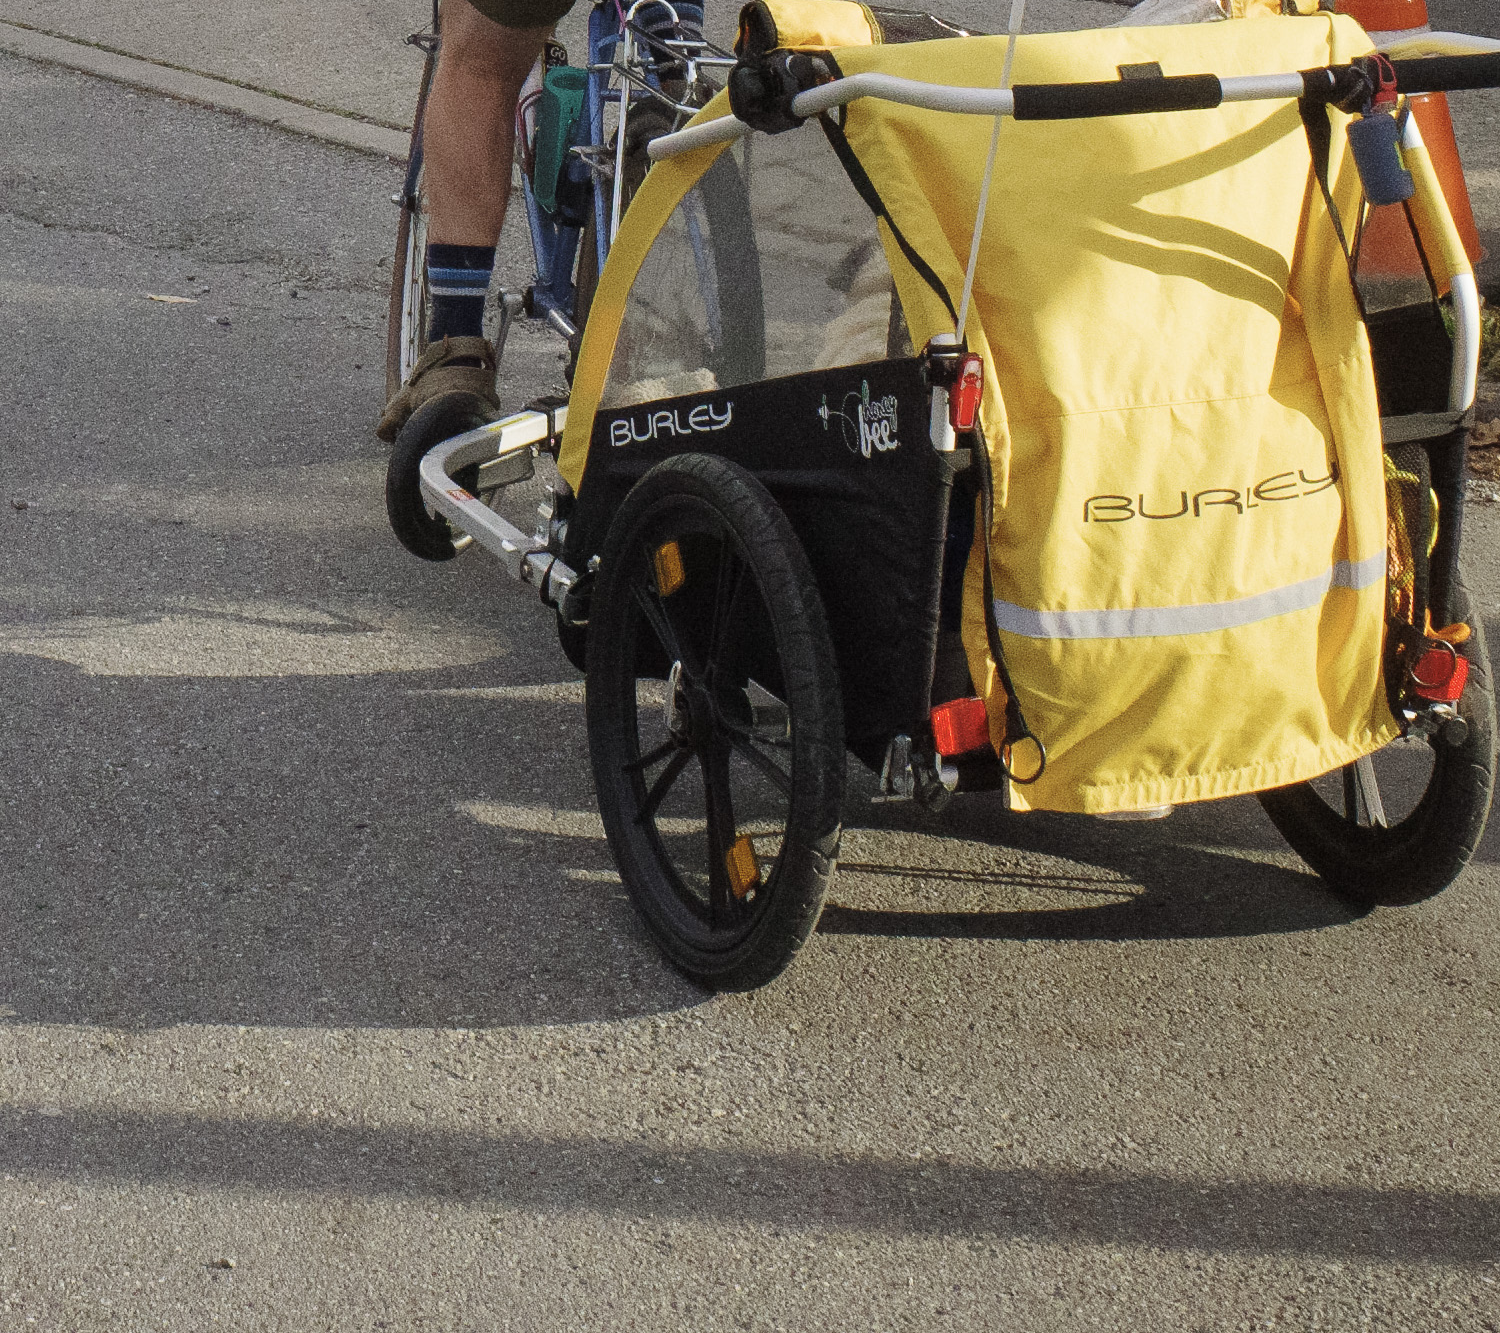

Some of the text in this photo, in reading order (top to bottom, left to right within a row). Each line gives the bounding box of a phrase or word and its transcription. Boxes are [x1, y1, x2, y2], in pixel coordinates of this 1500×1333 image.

[610, 401, 733, 447] BURLEY
[858, 403, 899, 458] bee
[862, 379, 898, 433] honey
[1083, 463, 1339, 523] BURLEY
